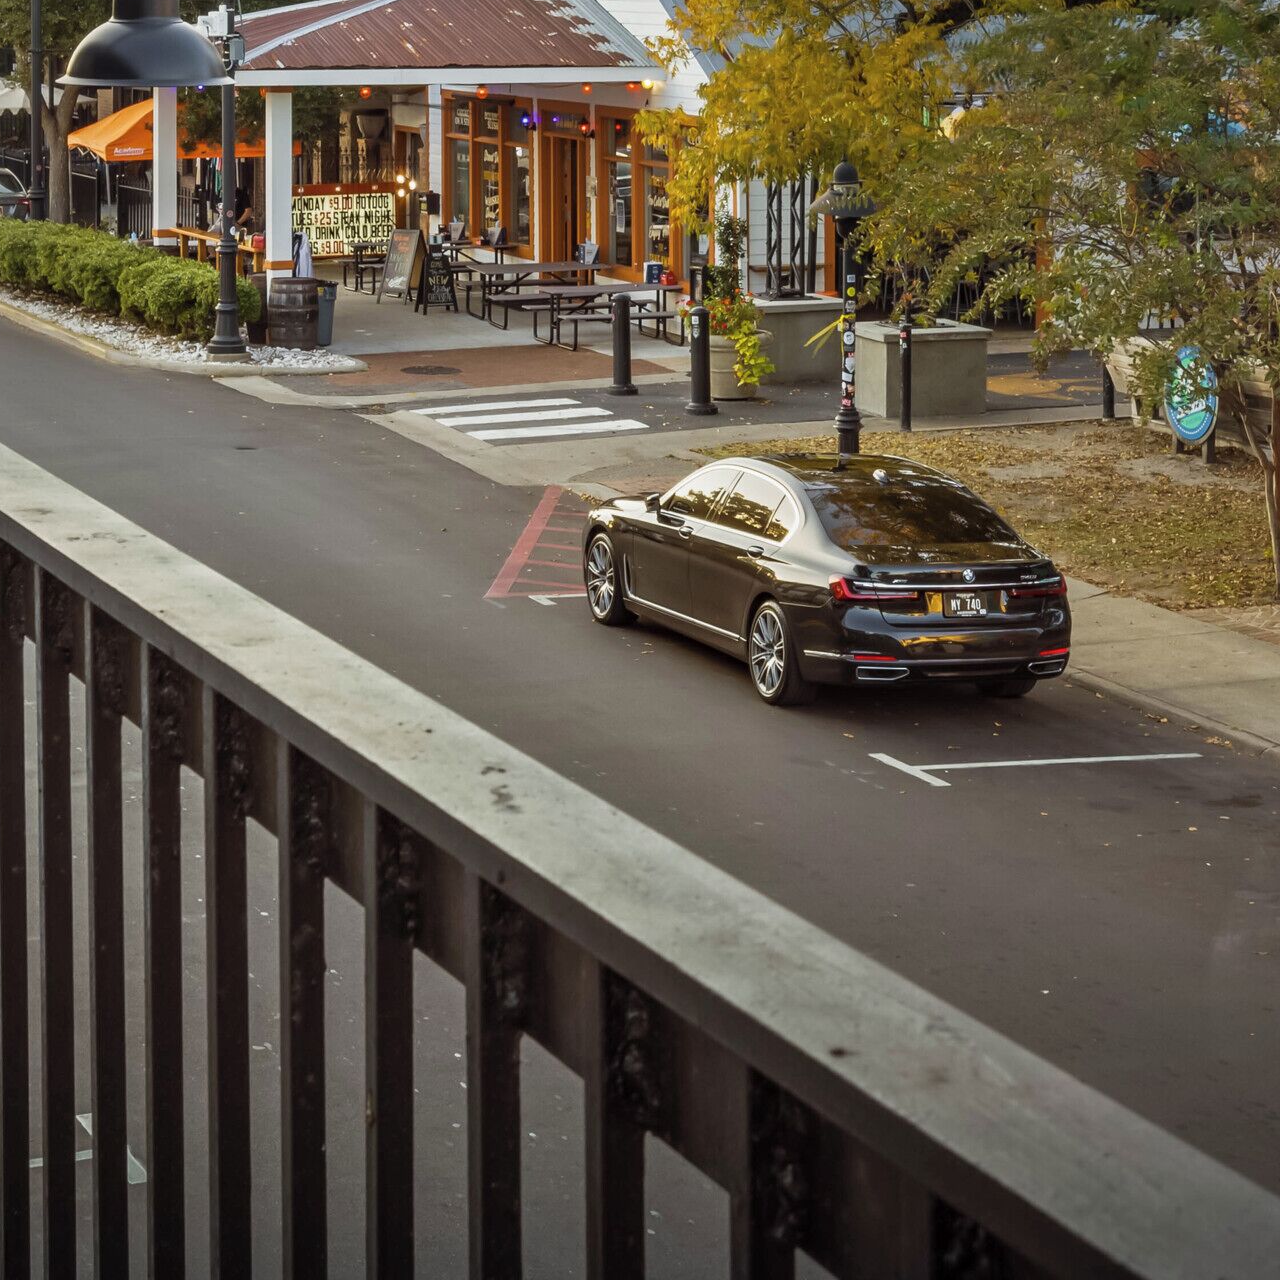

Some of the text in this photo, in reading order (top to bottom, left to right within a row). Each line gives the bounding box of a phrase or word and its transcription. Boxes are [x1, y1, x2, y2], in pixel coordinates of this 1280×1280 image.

[292, 197, 325, 211] MONDAY
[329, 196, 353, 211] $9.00
[333, 211, 360, 225] STEAK
[364, 210, 391, 223] NIGHT
[315, 226, 340, 240] DRINK
[345, 225, 368, 239] COLD
[428, 275, 449, 286] NEW
[966, 598, 981, 610] 740
